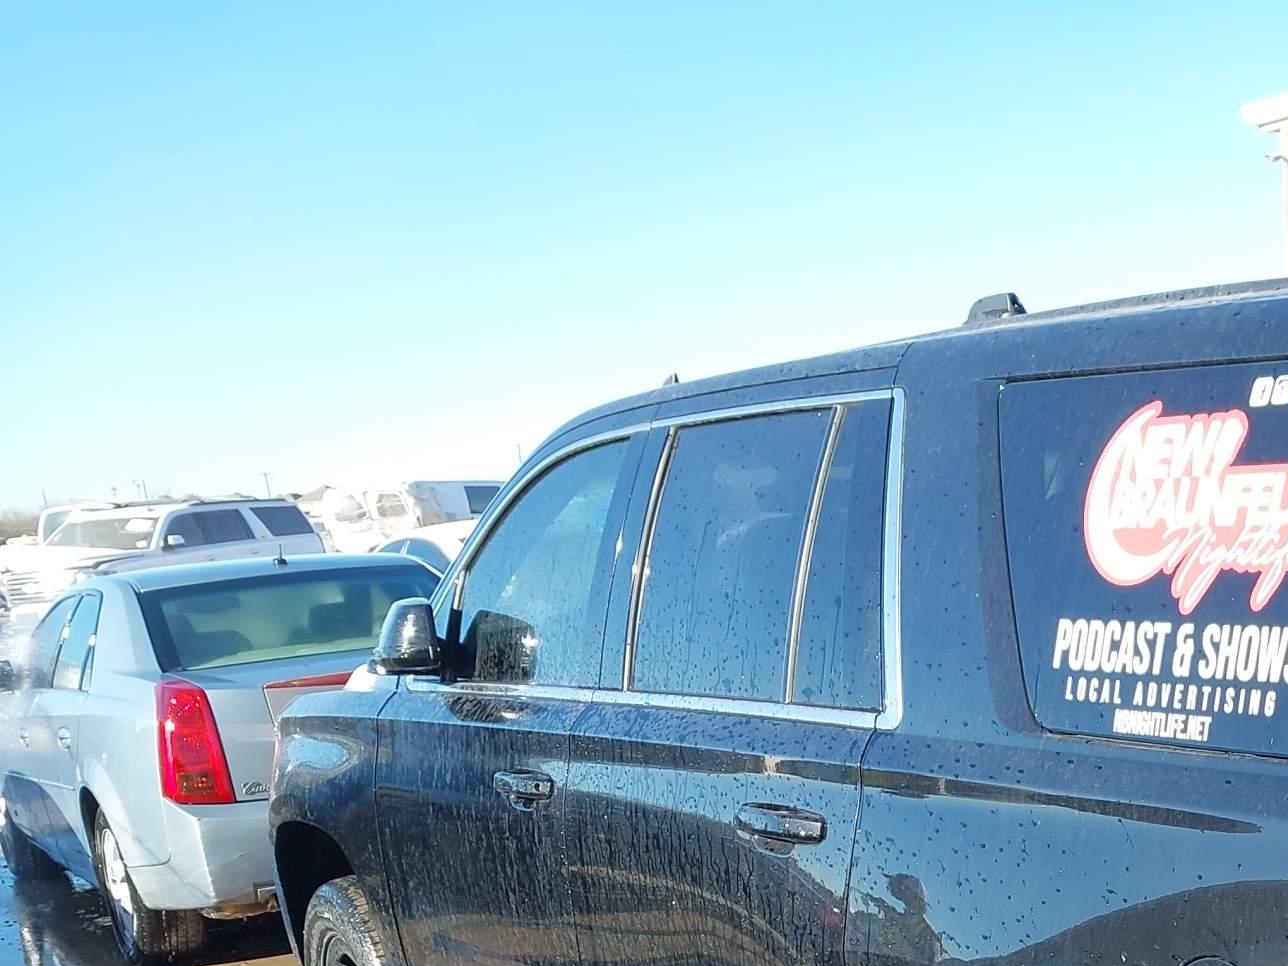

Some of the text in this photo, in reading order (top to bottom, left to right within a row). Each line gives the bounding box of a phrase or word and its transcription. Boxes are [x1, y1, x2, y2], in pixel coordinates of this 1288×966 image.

[1053, 618, 1172, 675] PODCAST
[1172, 623, 1195, 678] &
[1065, 676, 1277, 717] LOCAL ADVERTISING
[1112, 708, 1213, 742] NBNIGHTLIFE.NET
